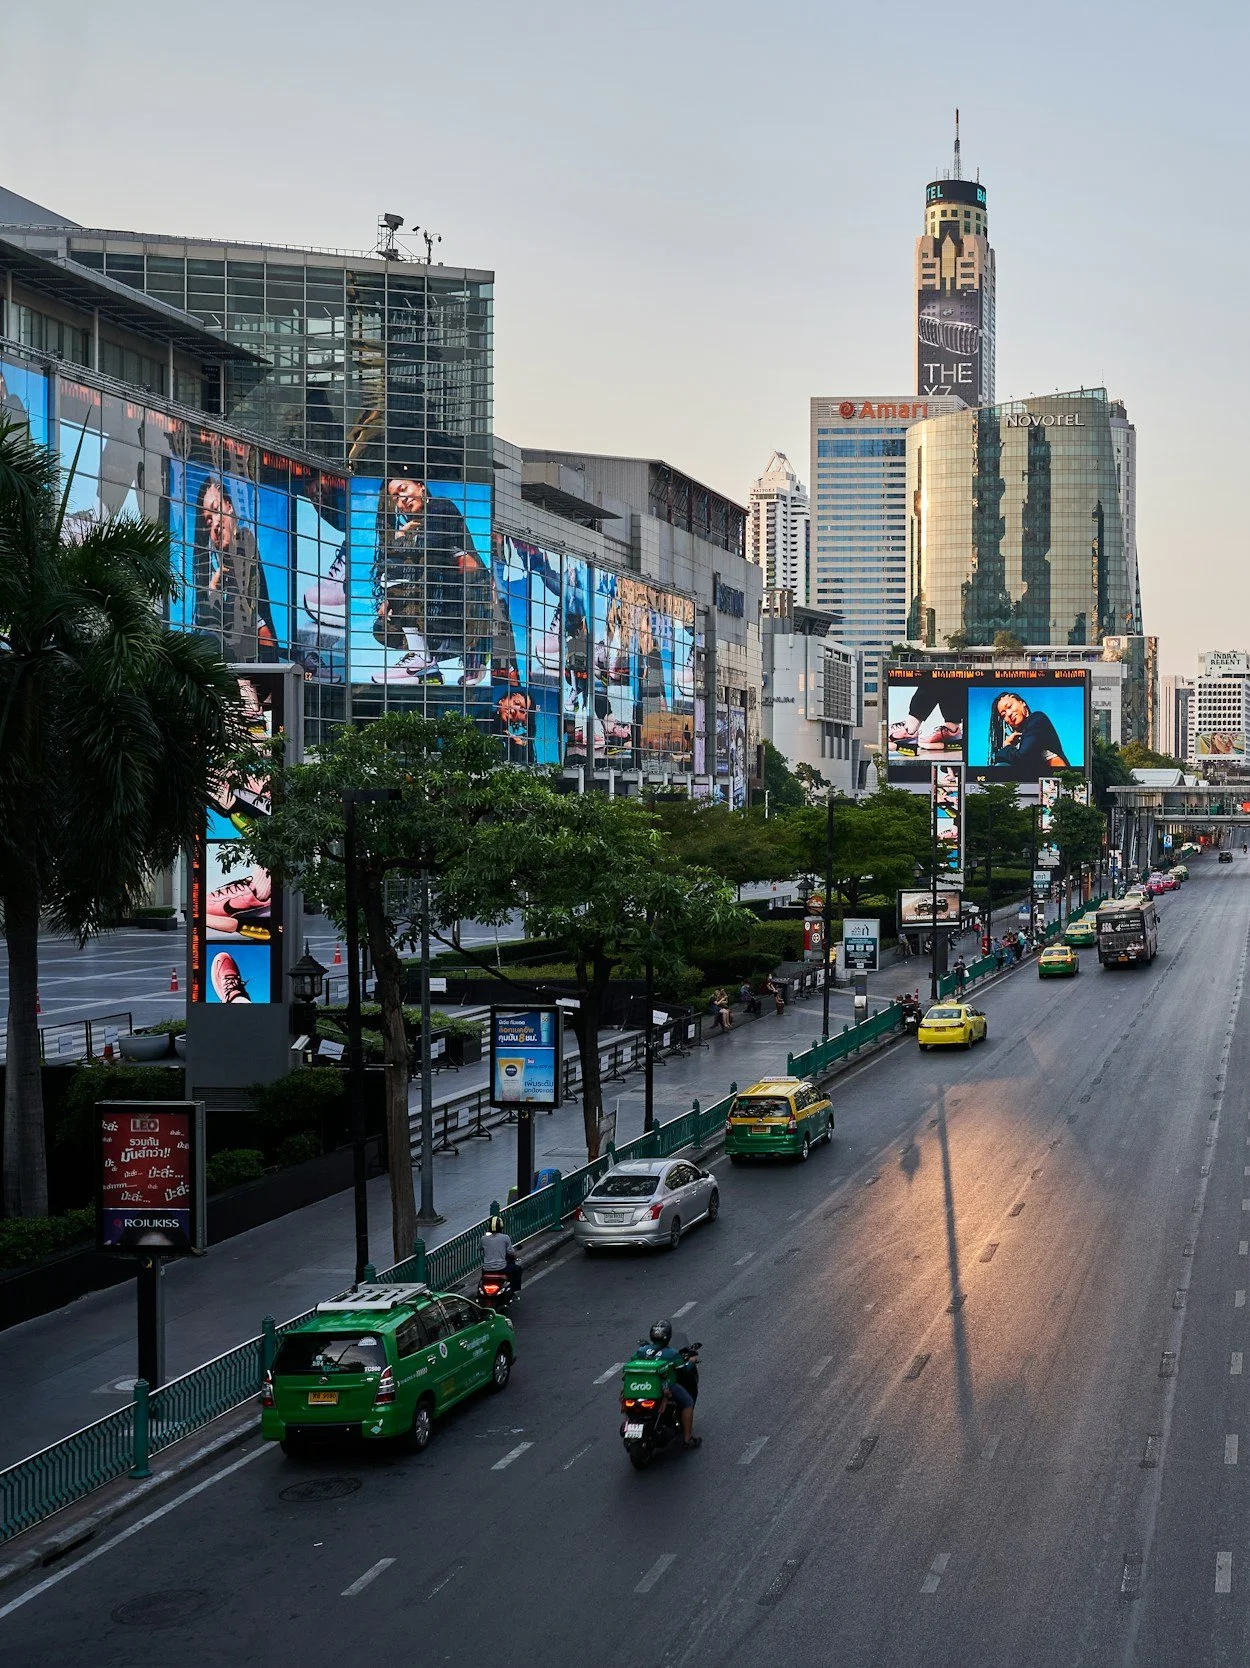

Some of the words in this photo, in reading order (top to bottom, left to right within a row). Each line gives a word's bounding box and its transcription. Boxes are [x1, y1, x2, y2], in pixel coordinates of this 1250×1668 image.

[924, 363, 972, 384] THE
[858, 401, 928, 420] Amari
[1005, 414, 1086, 427] NOVOTEL
[132, 1120, 158, 1130] LEO
[130, 1136, 160, 1146] รวมกัน
[124, 1219, 180, 1228] ROJUKISS
[646, 1348, 662, 1356] Grb
[630, 1382, 652, 1391] Grab
